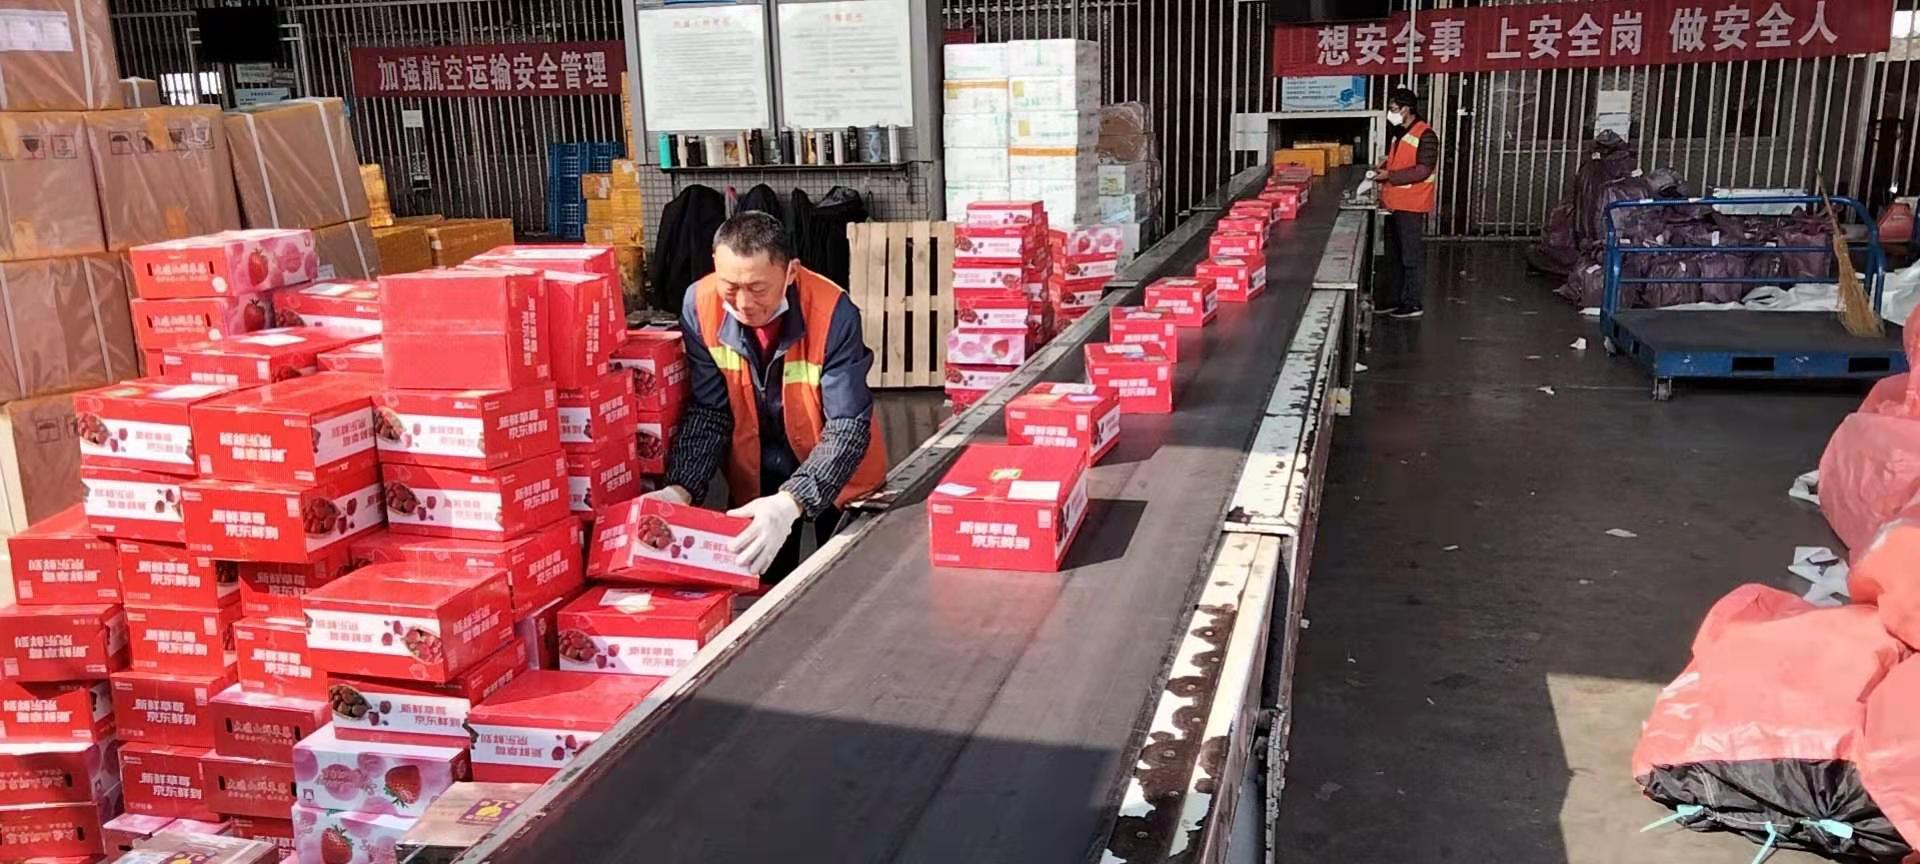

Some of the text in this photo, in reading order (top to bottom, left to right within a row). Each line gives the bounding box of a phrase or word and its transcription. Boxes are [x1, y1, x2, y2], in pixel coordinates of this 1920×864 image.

[1317, 1, 1838, 66] 想安全事 上安全岗 做安全人
[377, 50, 609, 91] 加强航空运输安全管理
